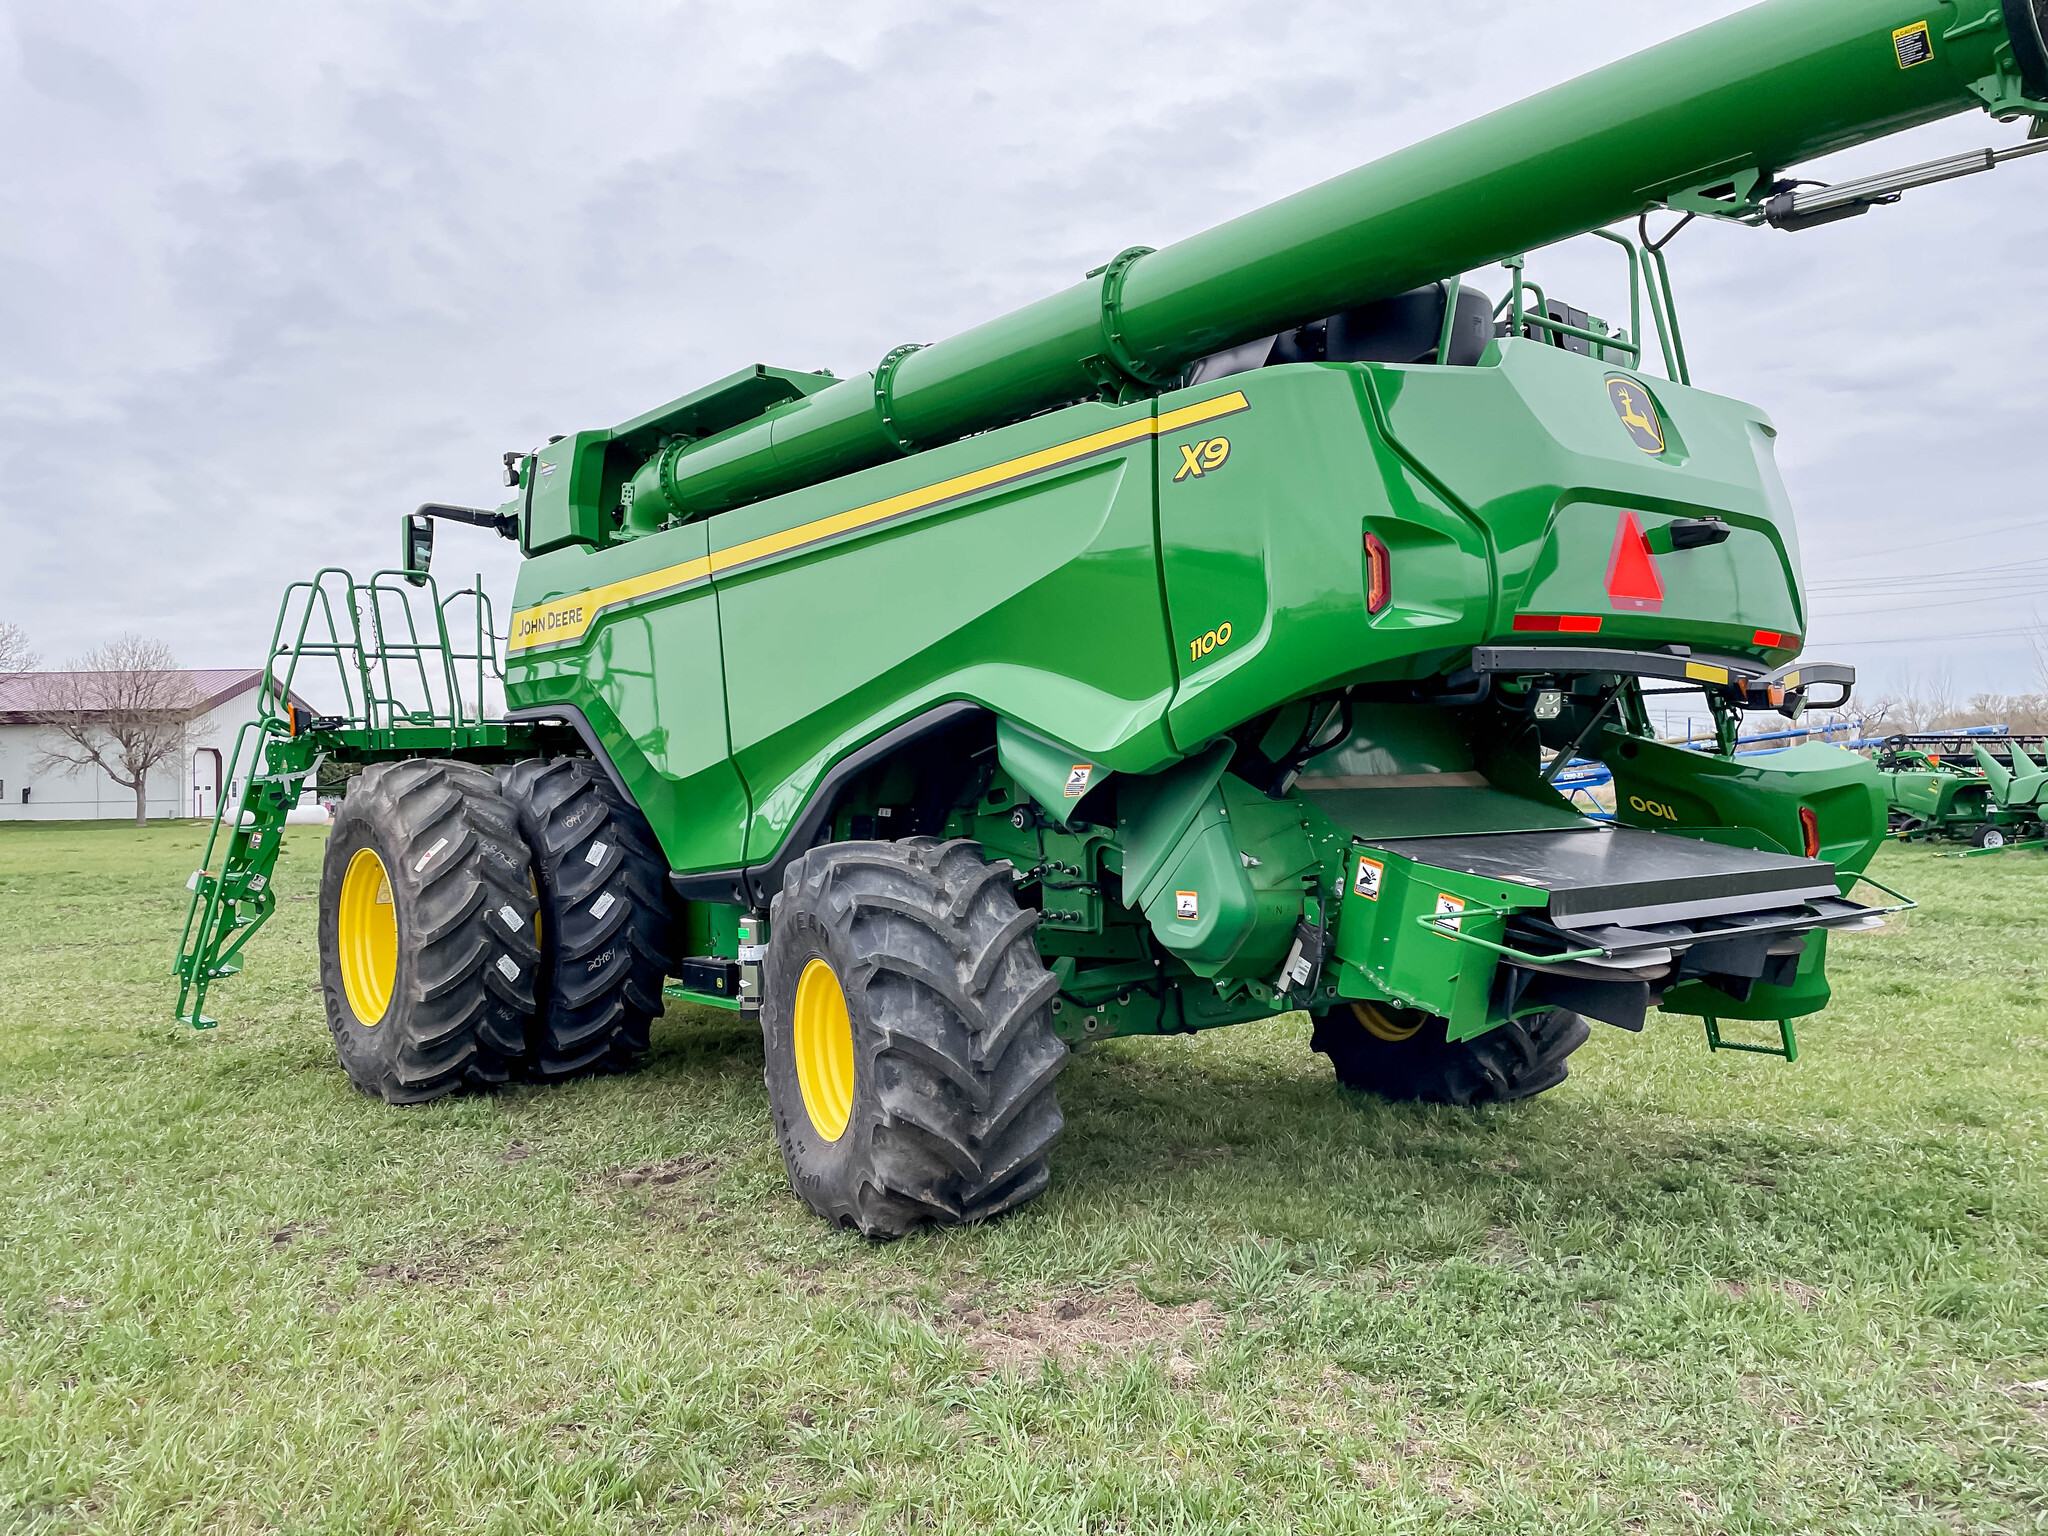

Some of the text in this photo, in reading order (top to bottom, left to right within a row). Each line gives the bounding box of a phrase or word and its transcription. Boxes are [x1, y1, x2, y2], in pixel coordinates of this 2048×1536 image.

[1173, 436, 1231, 483] X9
[518, 606, 583, 637] JOHN DEERE
[1190, 620, 1233, 663] 1100
